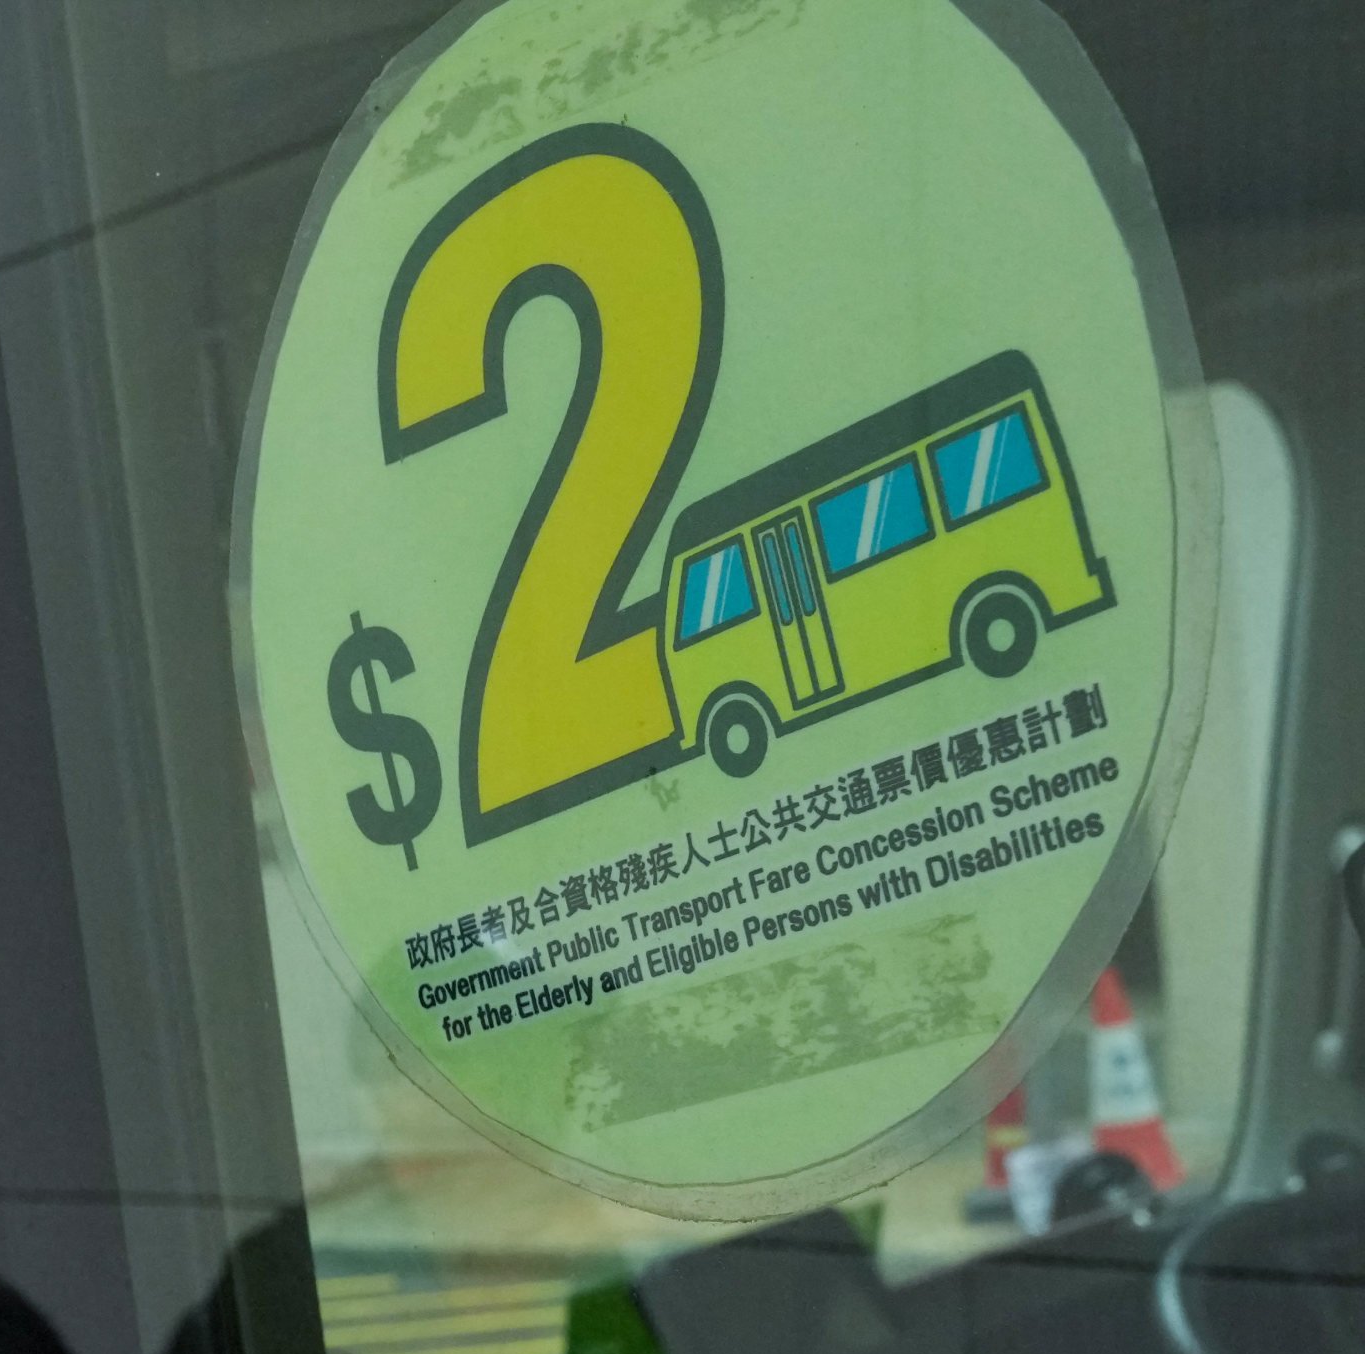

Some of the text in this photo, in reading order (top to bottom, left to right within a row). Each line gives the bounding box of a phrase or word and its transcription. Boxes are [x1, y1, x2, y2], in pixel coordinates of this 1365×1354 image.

[418, 756, 1120, 1010] Government Public Transport Fare Concession Scheme
[441, 811, 1106, 1042] for the Elderly and Eligible Persons with Disabilities
